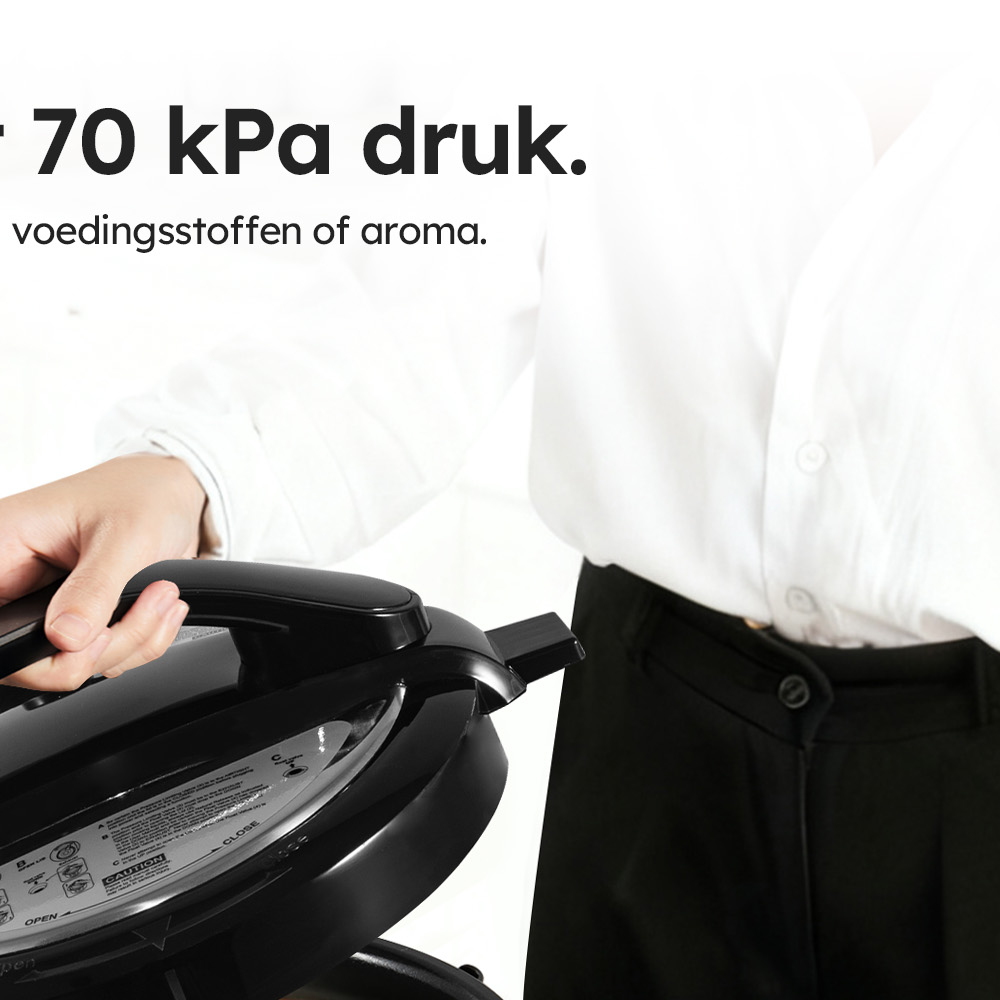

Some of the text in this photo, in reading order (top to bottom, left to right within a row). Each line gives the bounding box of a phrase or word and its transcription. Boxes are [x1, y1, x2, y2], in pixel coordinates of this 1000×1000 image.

[222, 820, 260, 845] CLOSE
[105, 855, 163, 883] CAUTION
[24, 913, 58, 926] OPEN
